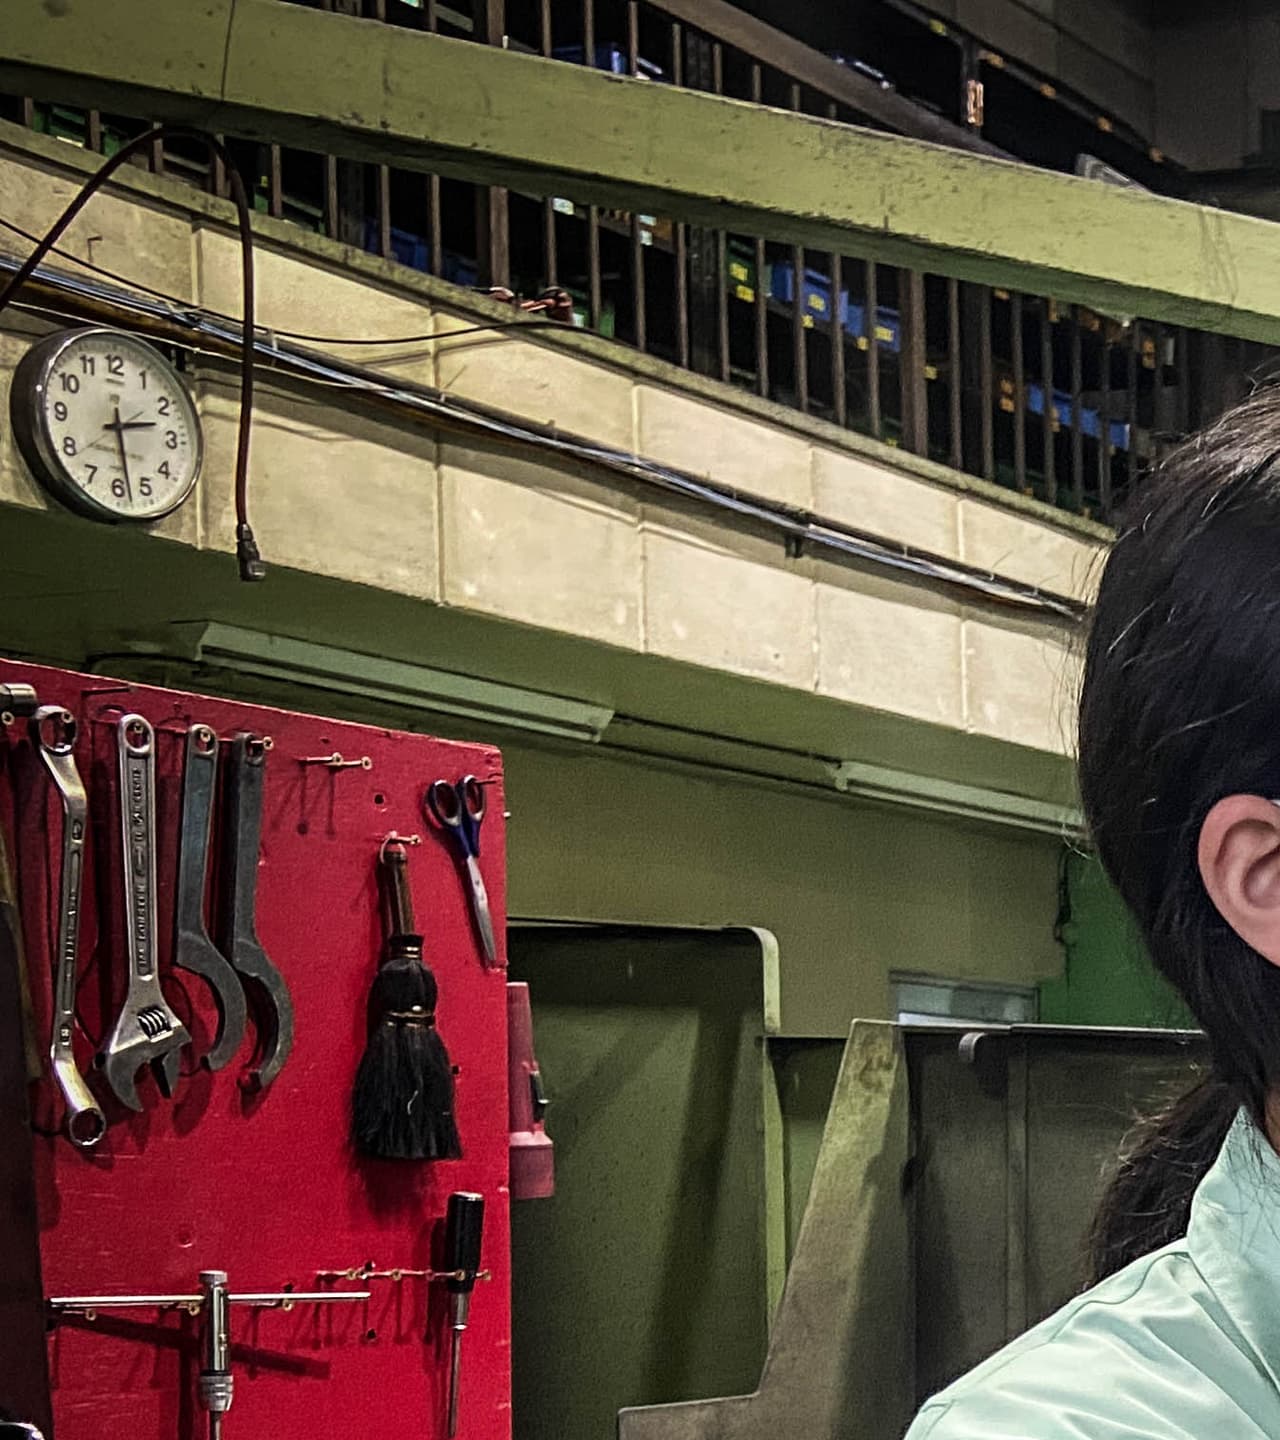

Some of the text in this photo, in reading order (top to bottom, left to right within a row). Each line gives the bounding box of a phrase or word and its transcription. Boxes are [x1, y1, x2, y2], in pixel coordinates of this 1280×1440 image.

[80, 354, 95, 376] 11
[105, 354, 124, 376] 12
[59, 372, 79, 393] 10
[139, 370, 146, 389] 1
[54, 401, 67, 421] 9
[157, 397, 169, 416] 2
[63, 437, 76, 456] 8
[165, 430, 177, 449] 3
[84, 464, 97, 484] 7
[158, 460, 170, 479] 4
[112, 478, 125, 498] 6
[139, 477, 151, 496] 5
